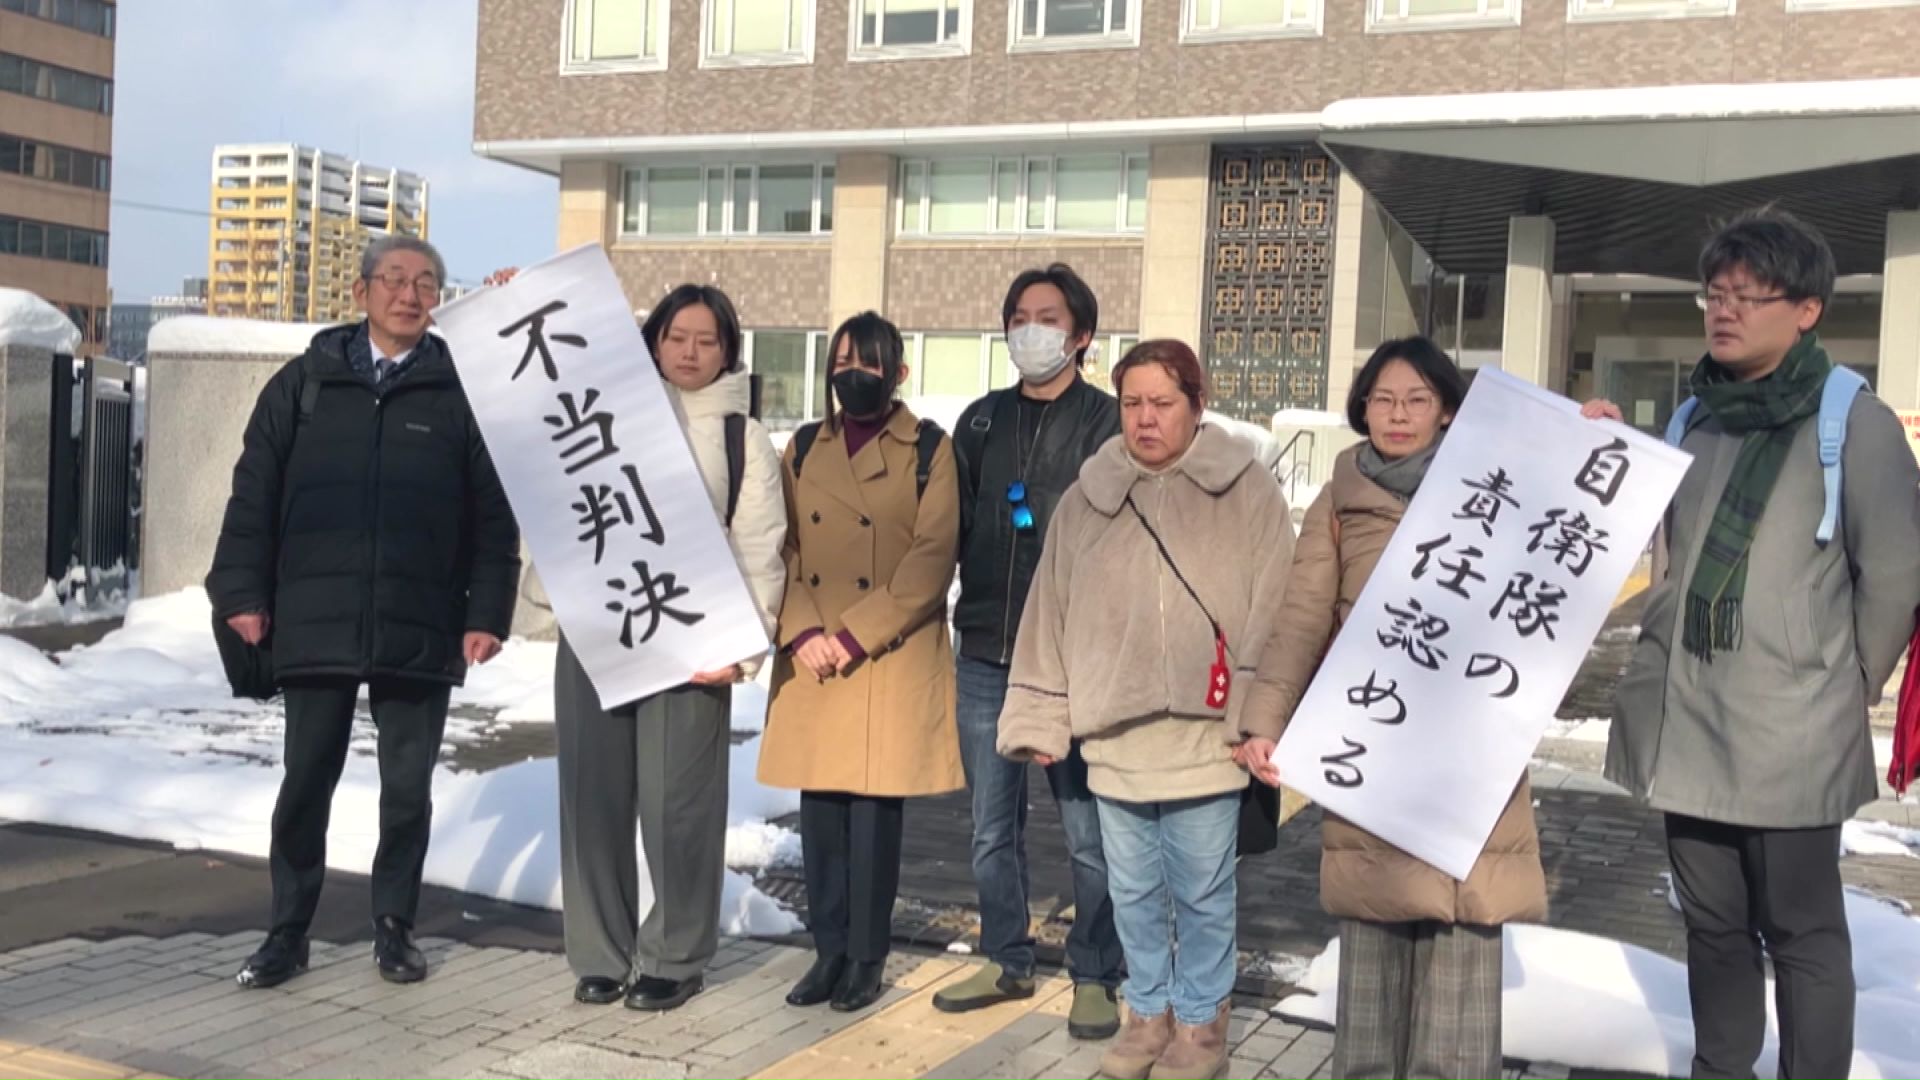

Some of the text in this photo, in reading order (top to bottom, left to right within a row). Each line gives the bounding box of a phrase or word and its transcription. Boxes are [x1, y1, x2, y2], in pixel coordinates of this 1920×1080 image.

[498, 300, 705, 648] 不当判決
[1319, 467, 1521, 789] 責任認める
[1464, 437, 1630, 698] 自衛隊の
